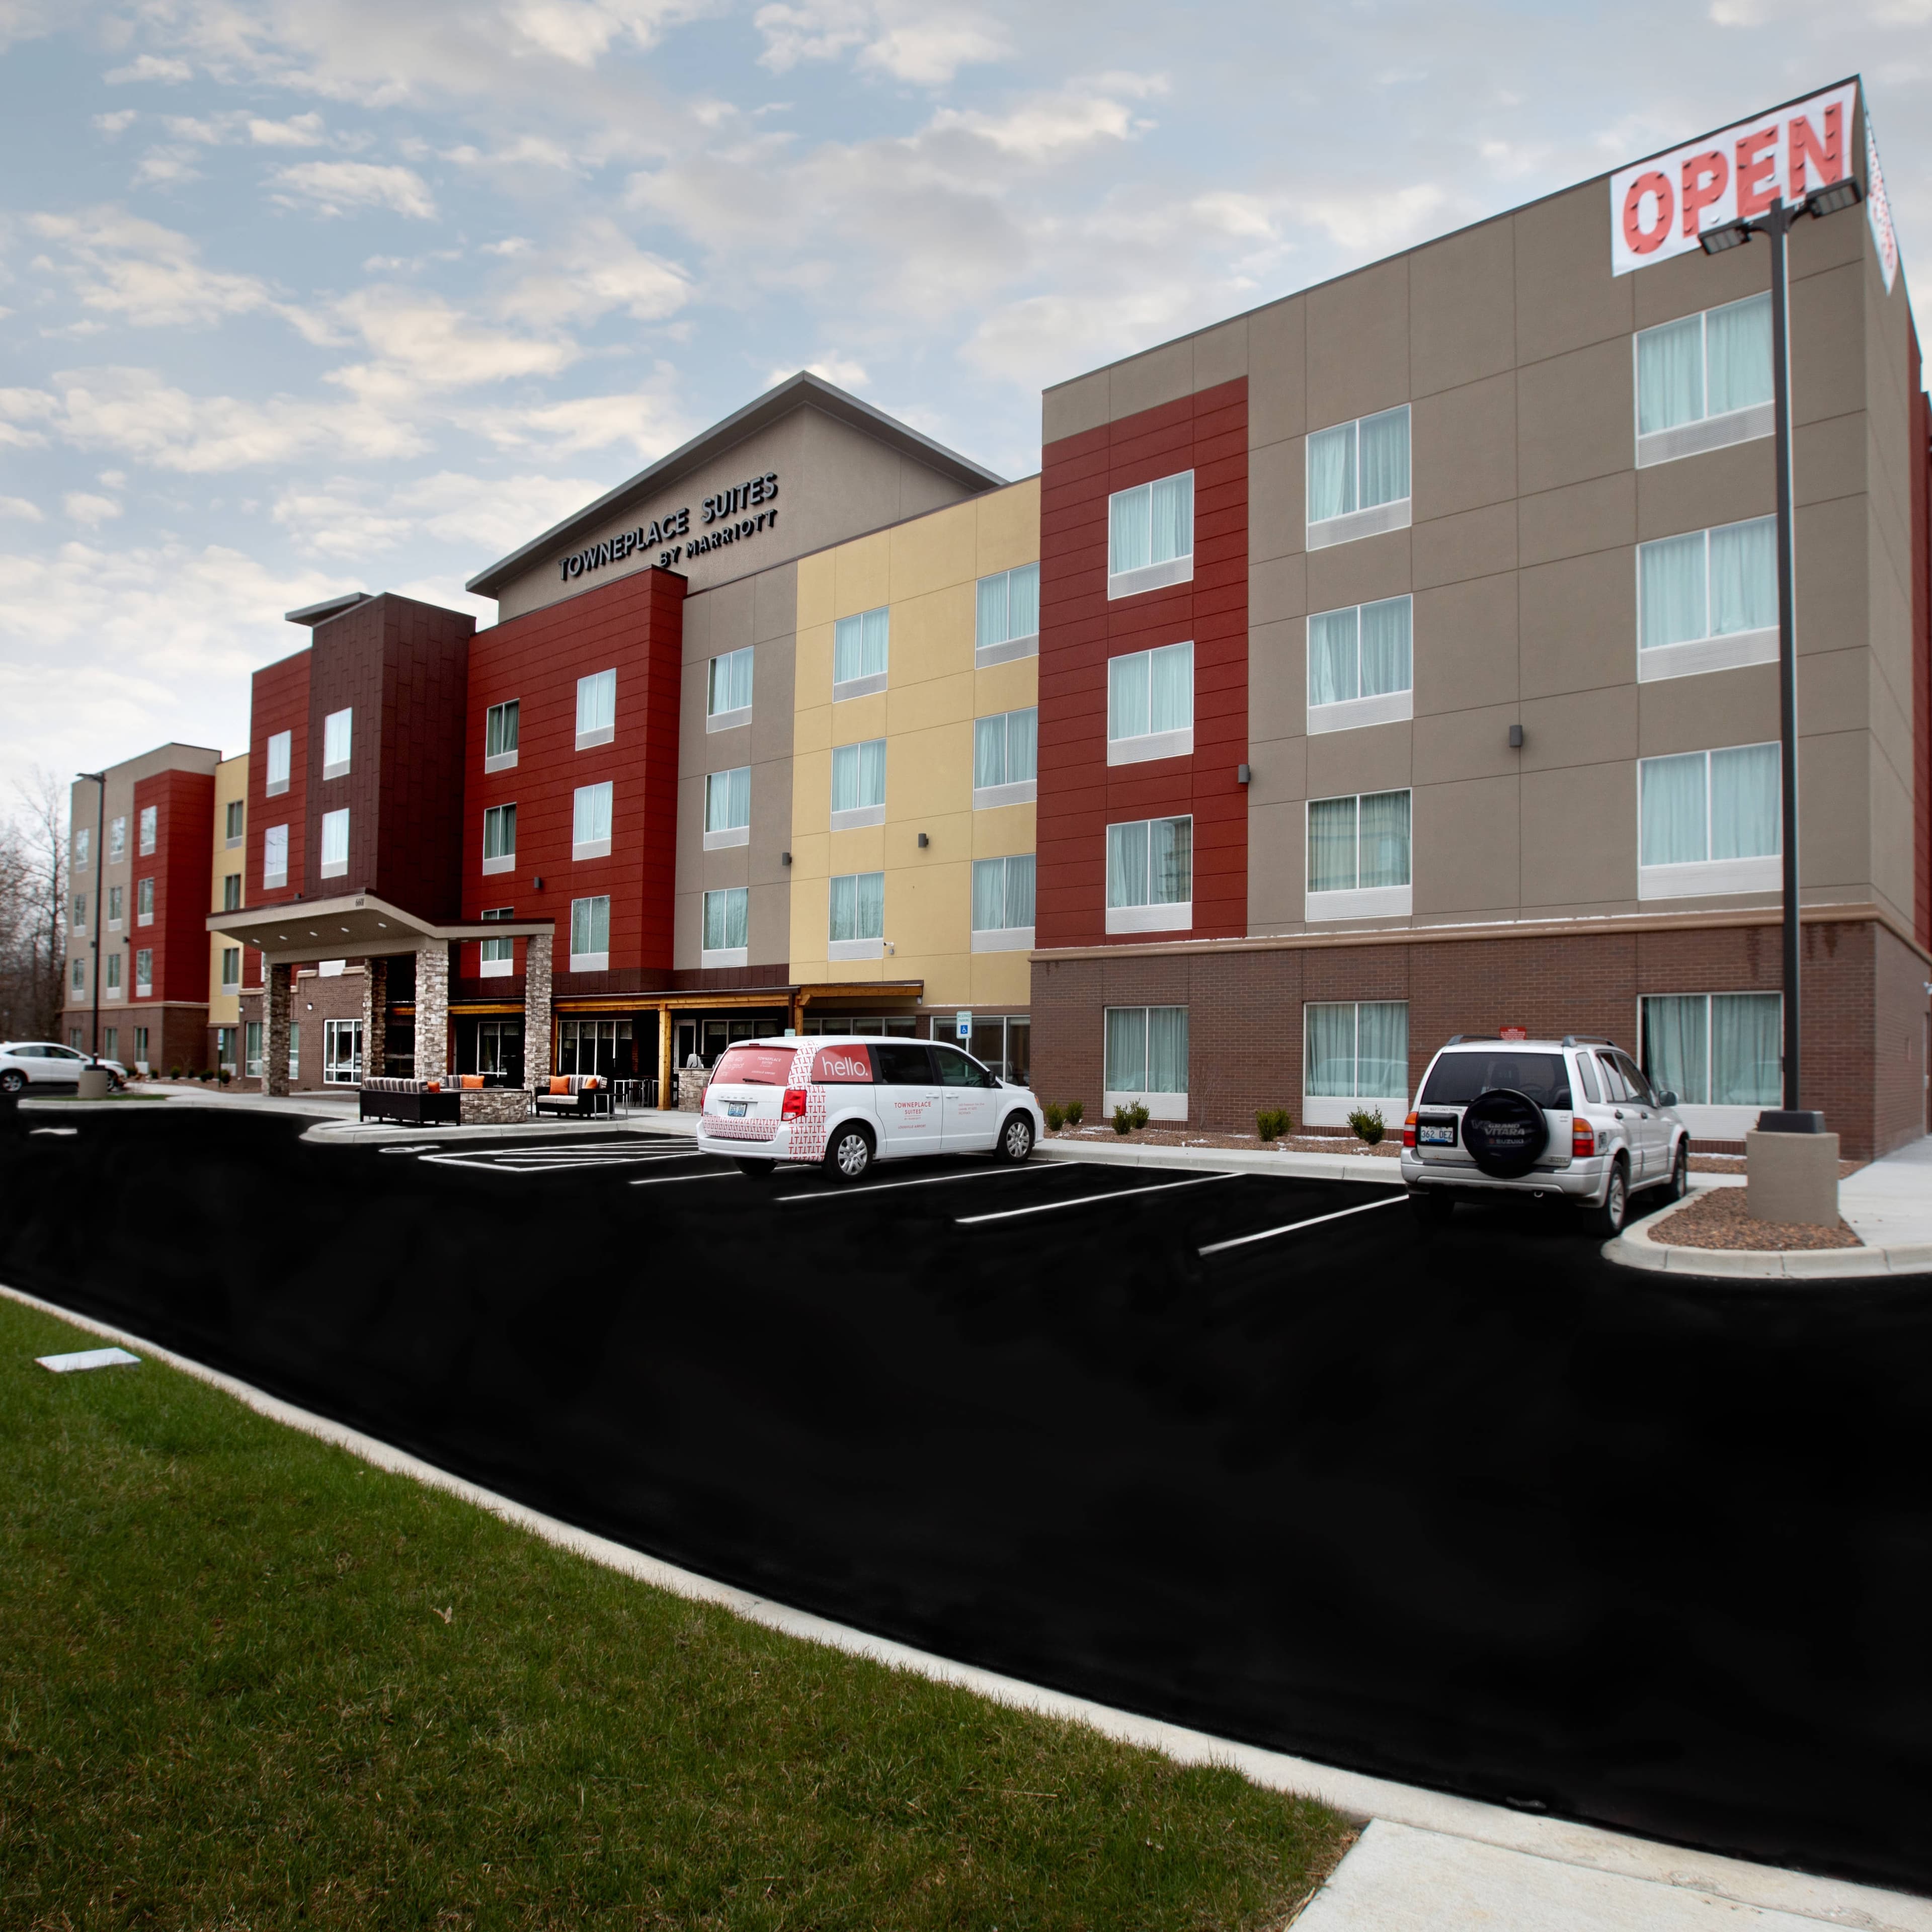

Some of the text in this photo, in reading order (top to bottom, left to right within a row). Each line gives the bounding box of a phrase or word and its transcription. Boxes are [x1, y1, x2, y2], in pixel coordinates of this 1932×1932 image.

[1623, 101, 1842, 255] OPEN
[558, 472, 777, 581] TOWNEPLACE SUITES
[660, 509, 777, 568] BY MARRIOTT
[822, 1057, 868, 1076] hello.
